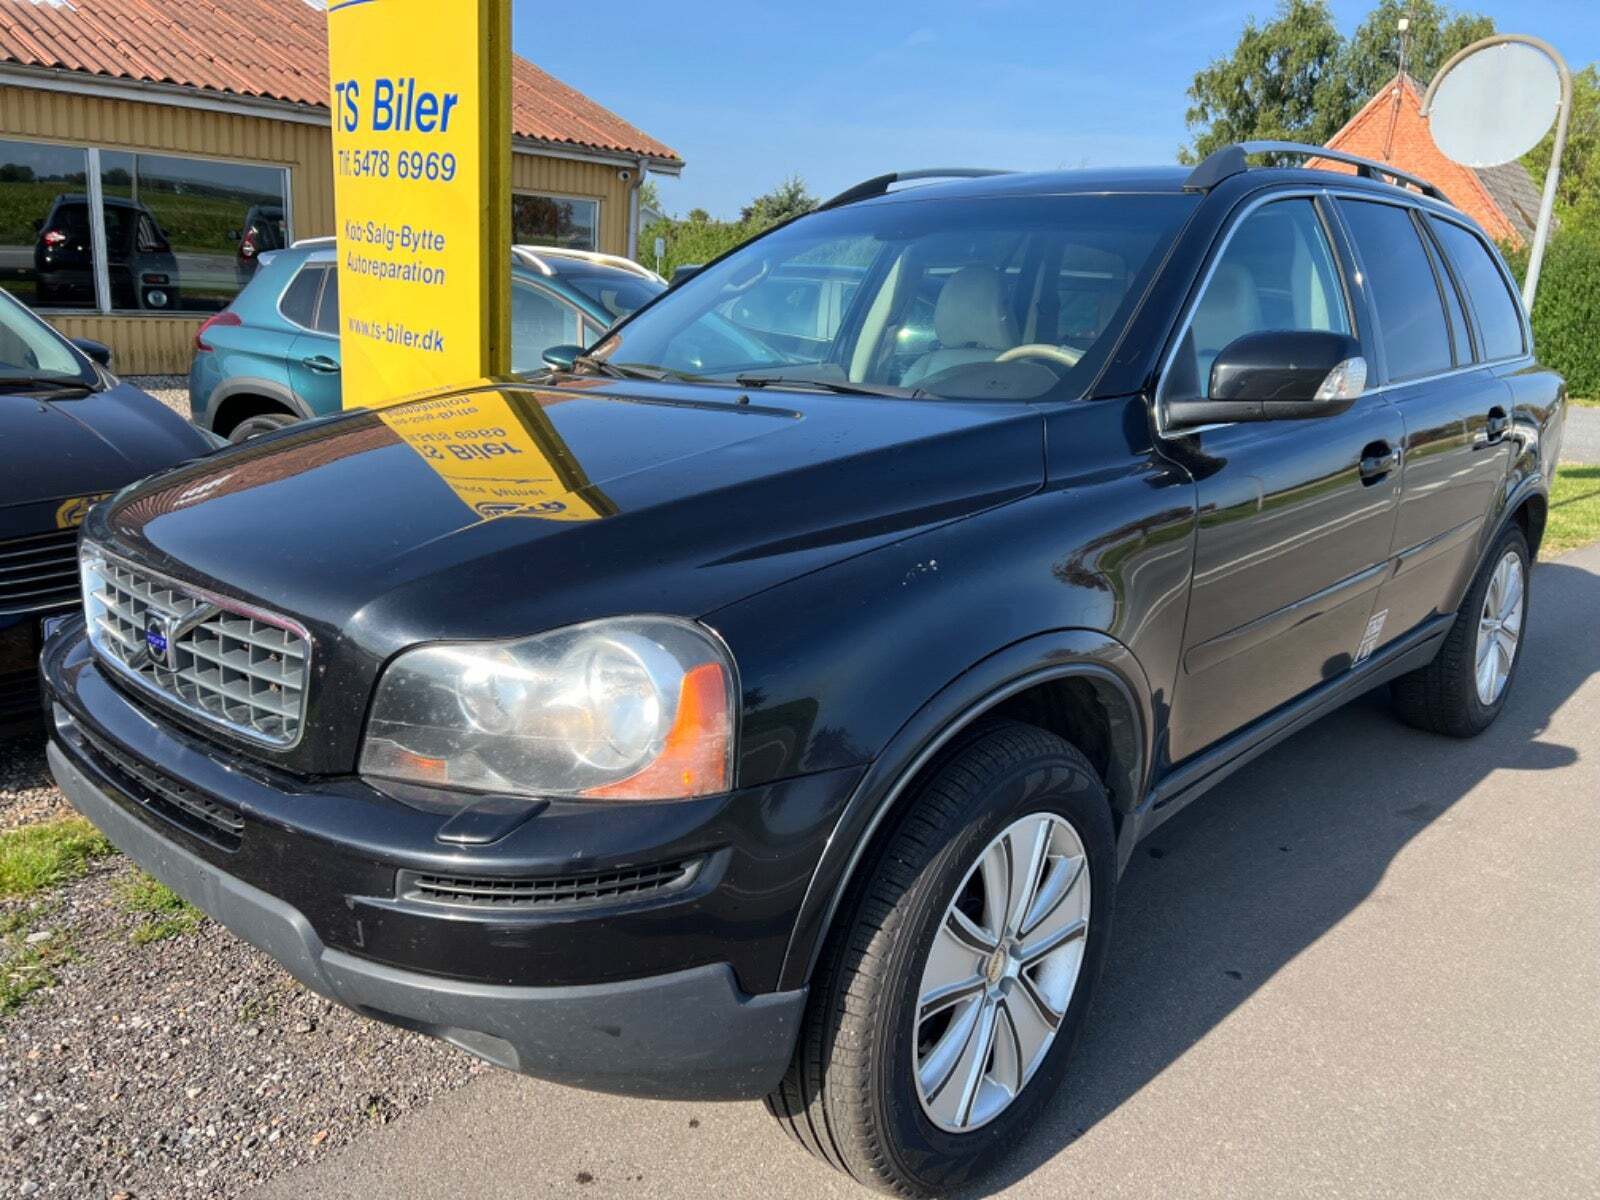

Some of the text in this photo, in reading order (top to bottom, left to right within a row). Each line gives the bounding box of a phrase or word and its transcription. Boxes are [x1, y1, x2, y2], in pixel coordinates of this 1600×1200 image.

[335, 78, 458, 132] TS Biler
[397, 151, 457, 181] 6969
[347, 251, 446, 286] Autoreparation
[348, 317, 444, 353] www.ts-biler.dk
